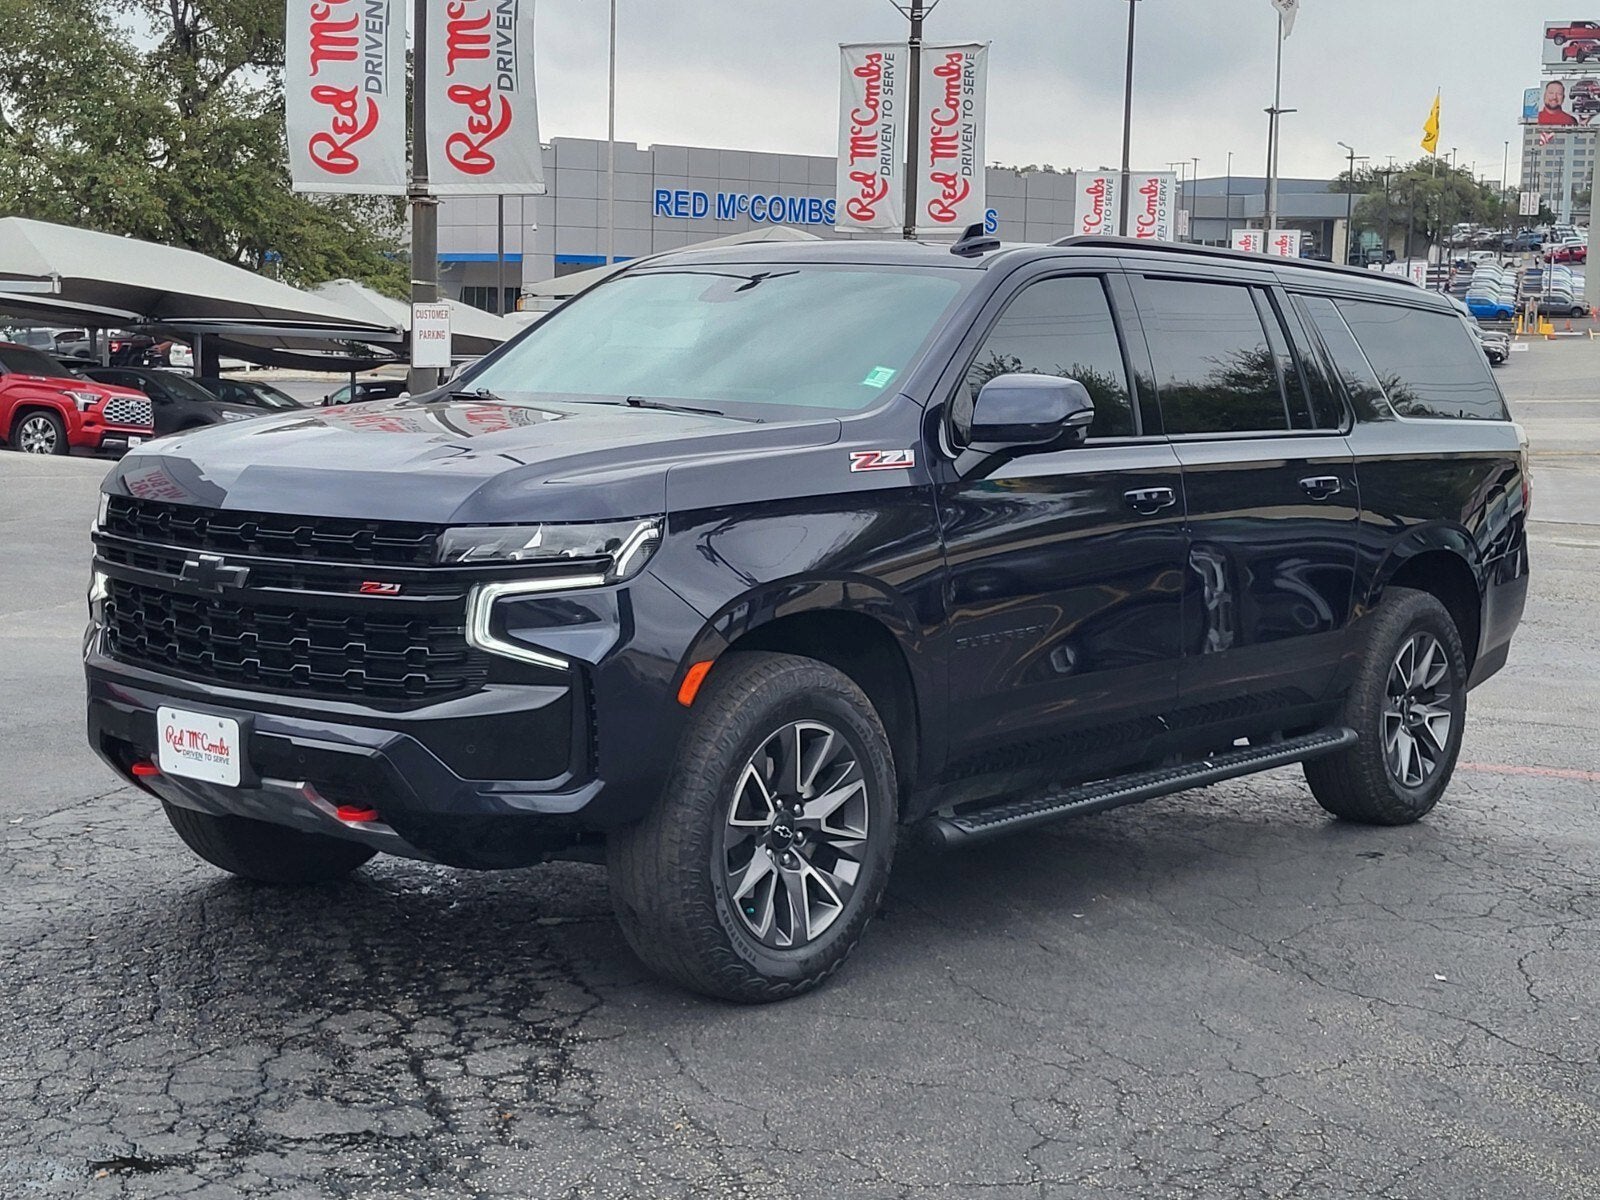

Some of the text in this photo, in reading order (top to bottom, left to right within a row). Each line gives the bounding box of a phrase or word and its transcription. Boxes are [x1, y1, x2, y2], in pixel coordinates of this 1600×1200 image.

[364, 0, 384, 94] DRIVEN
[880, 52, 895, 176] DRIVEN TO SERVE
[961, 52, 976, 176] DRIVEN TO SERVE
[308, 84, 379, 175] Red
[446, 83, 513, 175] Red
[846, 52, 889, 222] Red McCombs
[927, 52, 970, 223] Red McCombs
[654, 188, 709, 218] RED
[1105, 178, 1114, 207] SERVE
[1159, 178, 1168, 207] SERVE
[1104, 209, 1112, 221] TO
[1158, 209, 1166, 221] TO
[415, 309, 449, 320] CUSTOMER
[419, 330, 446, 340] PARKING
[849, 449, 915, 472] Z71
[360, 581, 402, 595] Z71
[166, 725, 230, 757] Red McCombs
[182, 749, 230, 765] DRIVEN TO SERVE
